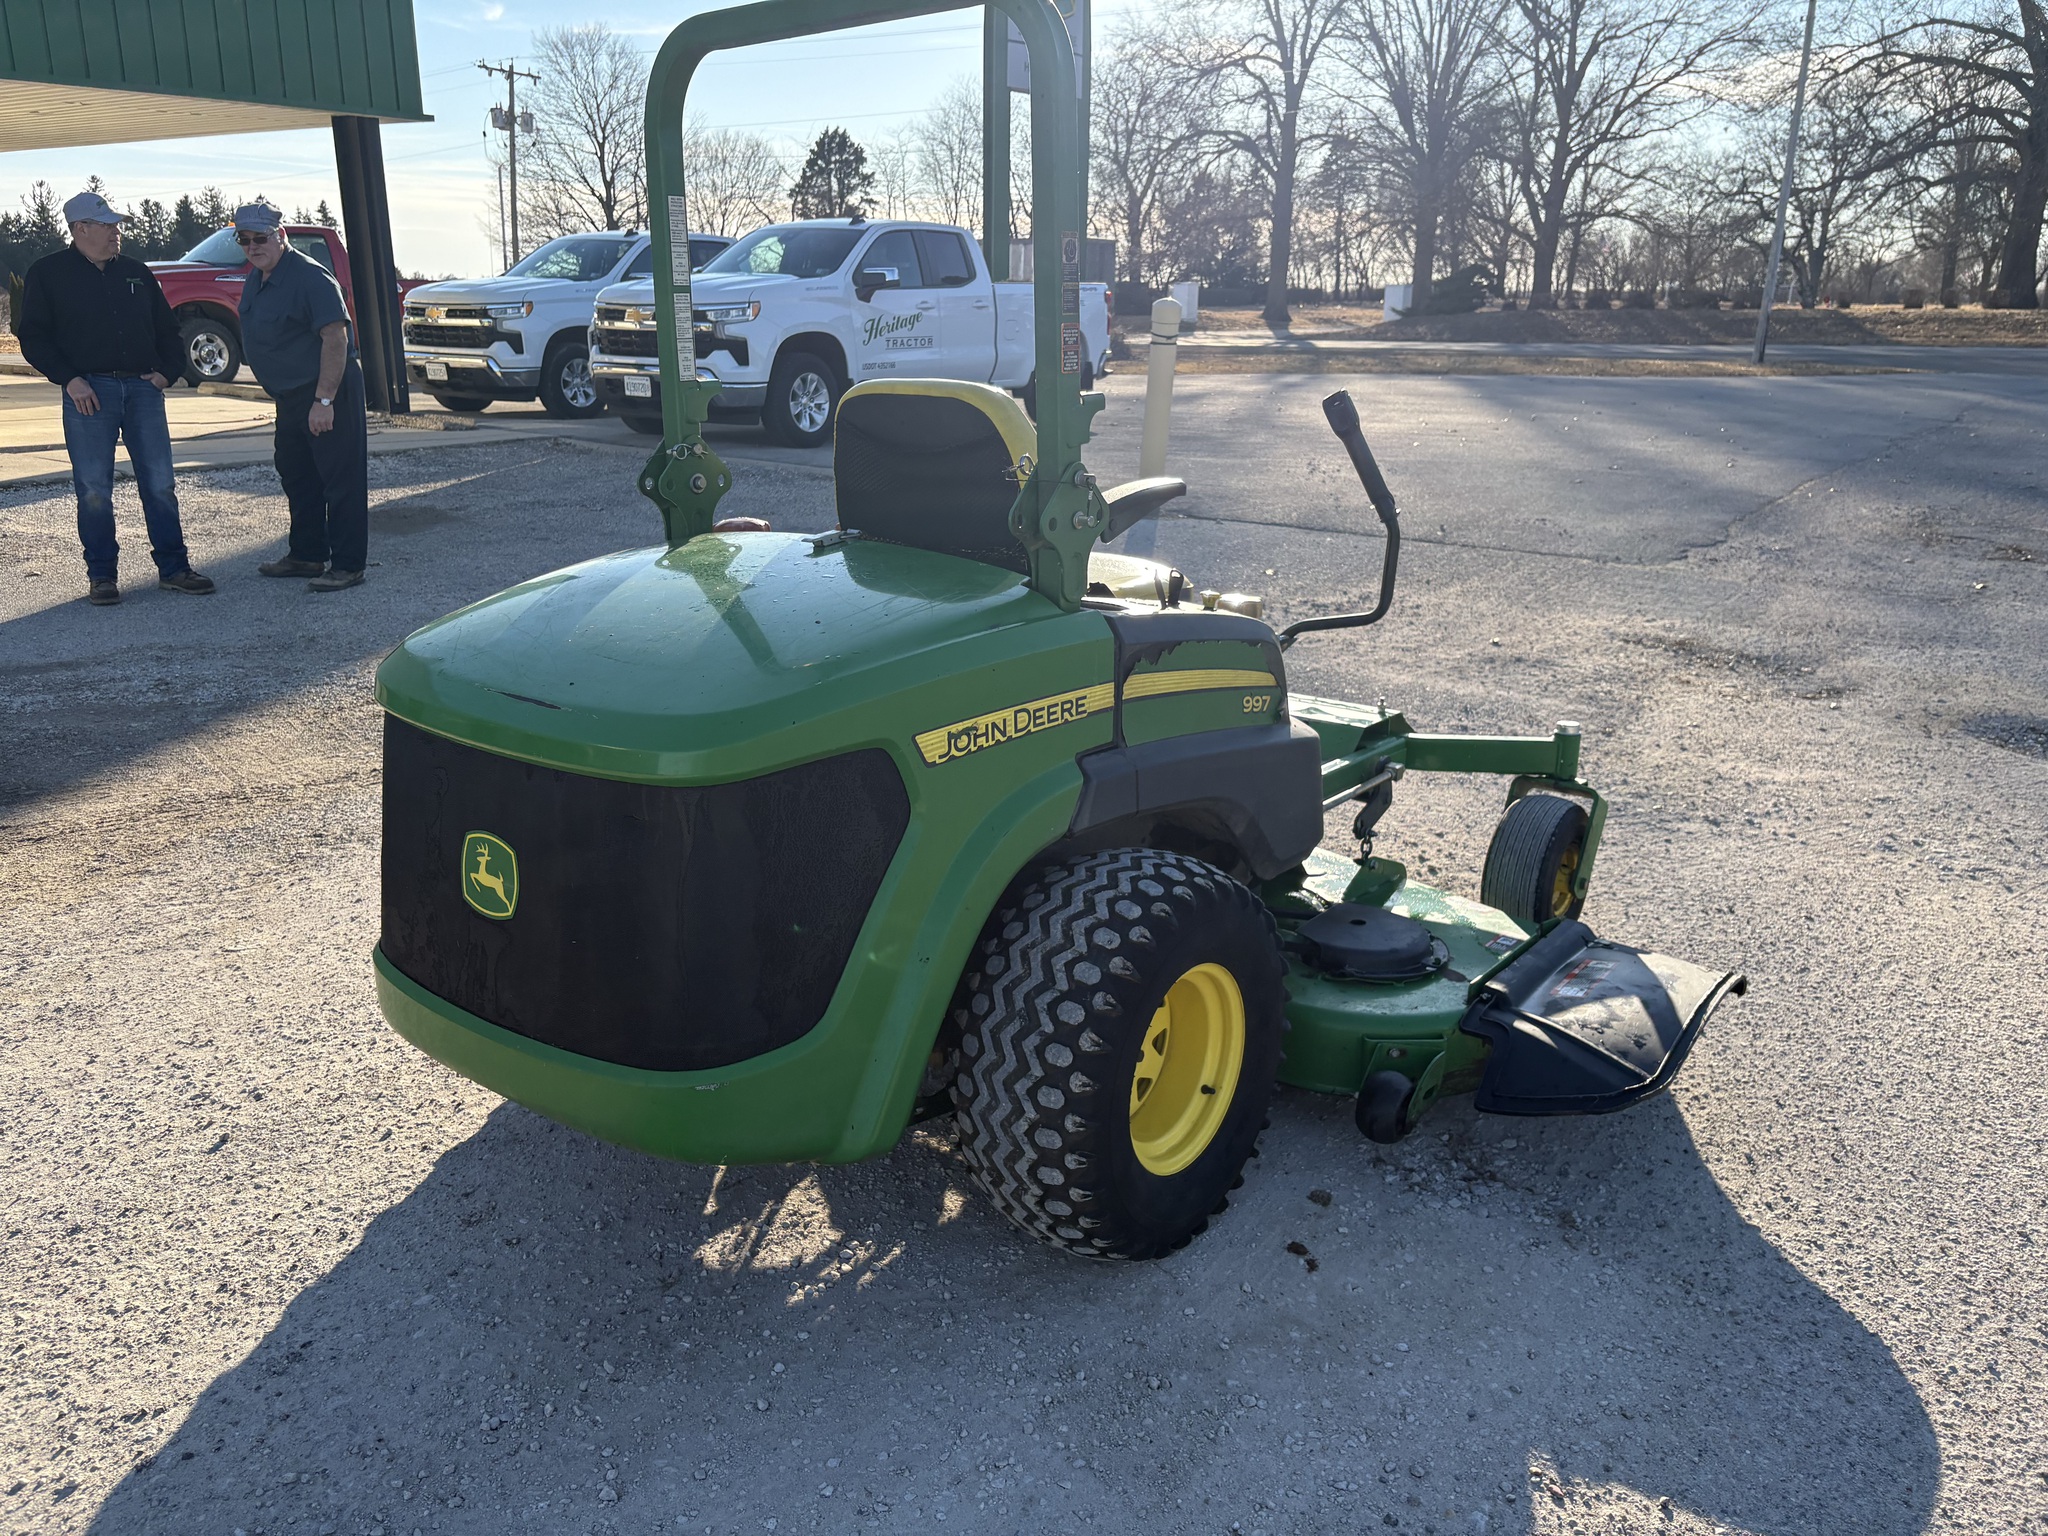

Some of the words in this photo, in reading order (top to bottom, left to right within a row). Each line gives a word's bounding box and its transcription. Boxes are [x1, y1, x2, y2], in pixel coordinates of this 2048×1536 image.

[863, 311, 923, 346] Heritage
[885, 337, 933, 348] TRACTOR
[862, 363, 877, 371] USDOT
[1242, 694, 1272, 713] 997
[938, 716, 1008, 760] JOHN
[1013, 695, 1088, 734] DEERE
